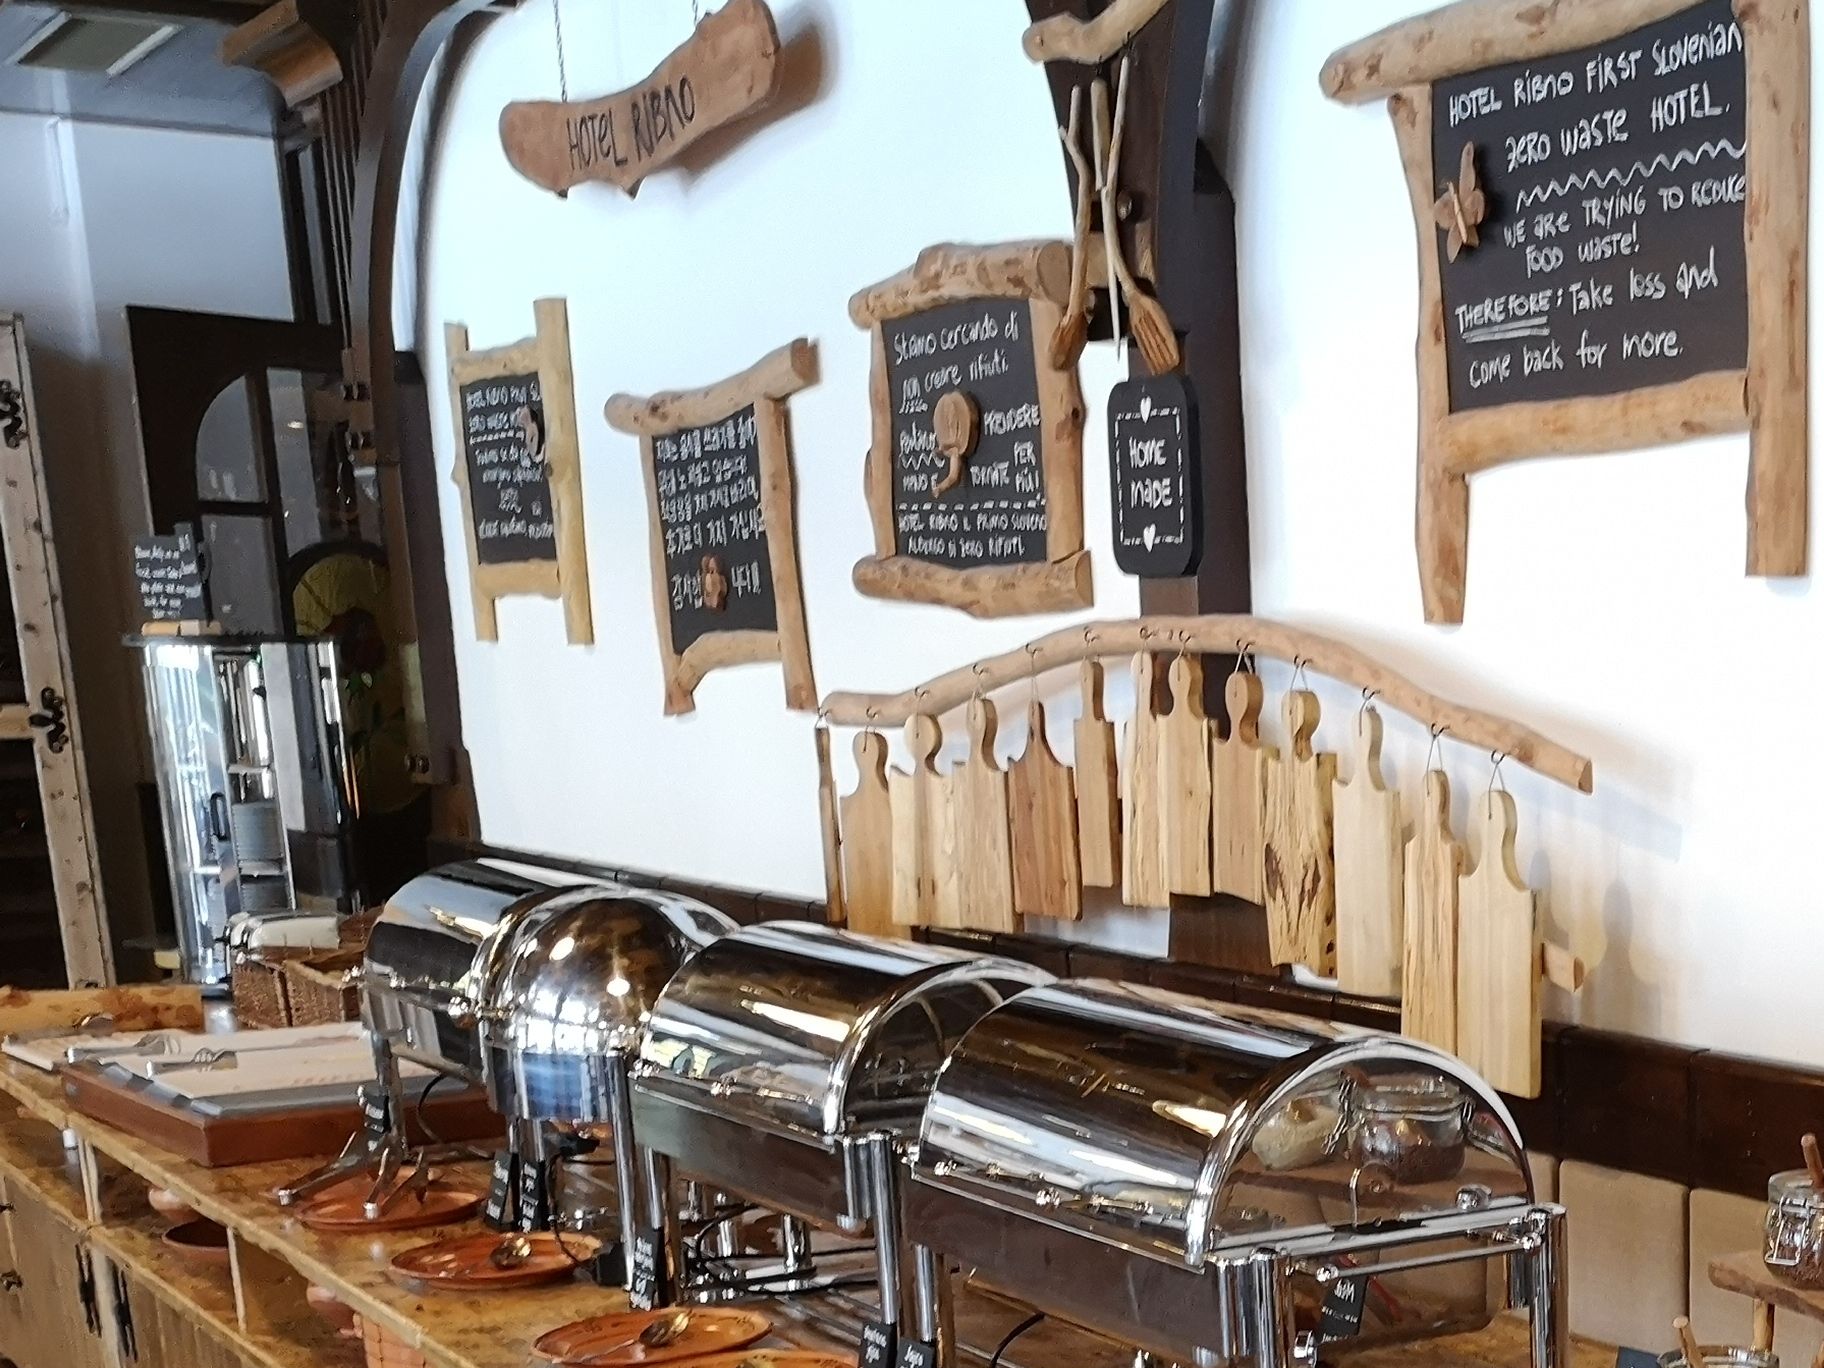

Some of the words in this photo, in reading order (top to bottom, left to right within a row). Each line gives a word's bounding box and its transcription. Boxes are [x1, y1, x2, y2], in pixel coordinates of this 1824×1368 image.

[1450, 87, 1502, 127] HOTEL
[1658, 186, 1683, 211] TO
[1569, 277, 1613, 315] Take
[1523, 340, 1564, 377] back
[1576, 329, 1607, 368] for
